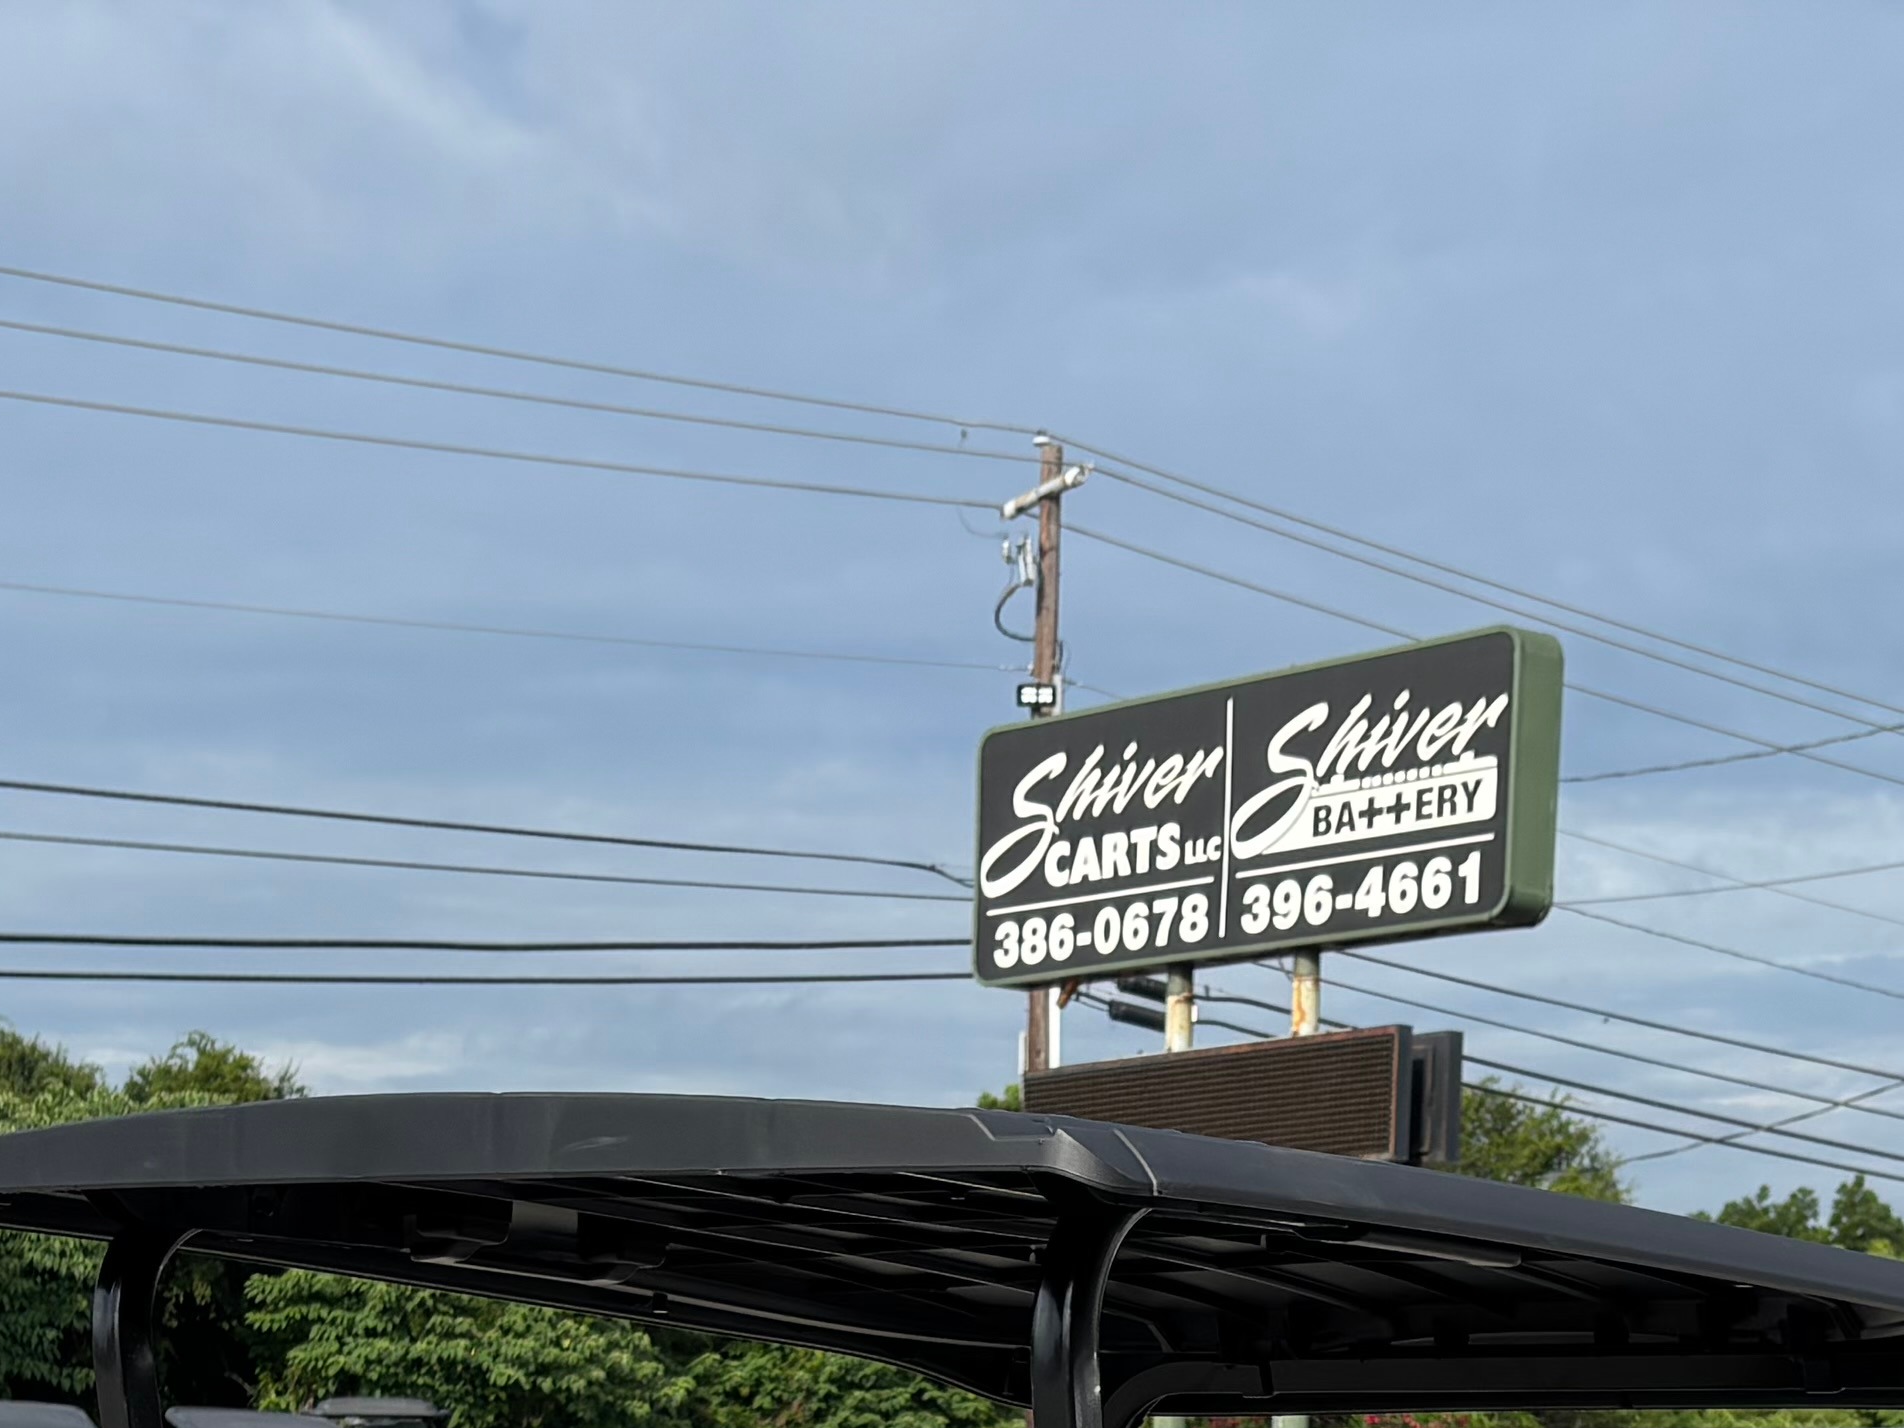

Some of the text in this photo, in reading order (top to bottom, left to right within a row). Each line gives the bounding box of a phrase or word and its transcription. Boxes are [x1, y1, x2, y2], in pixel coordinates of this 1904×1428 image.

[1231, 688, 1509, 860] Shiver
[981, 741, 1224, 899] Shiver
[1044, 822, 1222, 887] CARTS LLC
[993, 893, 1209, 969] 386-0678
[1240, 850, 1482, 935] 396-4661
